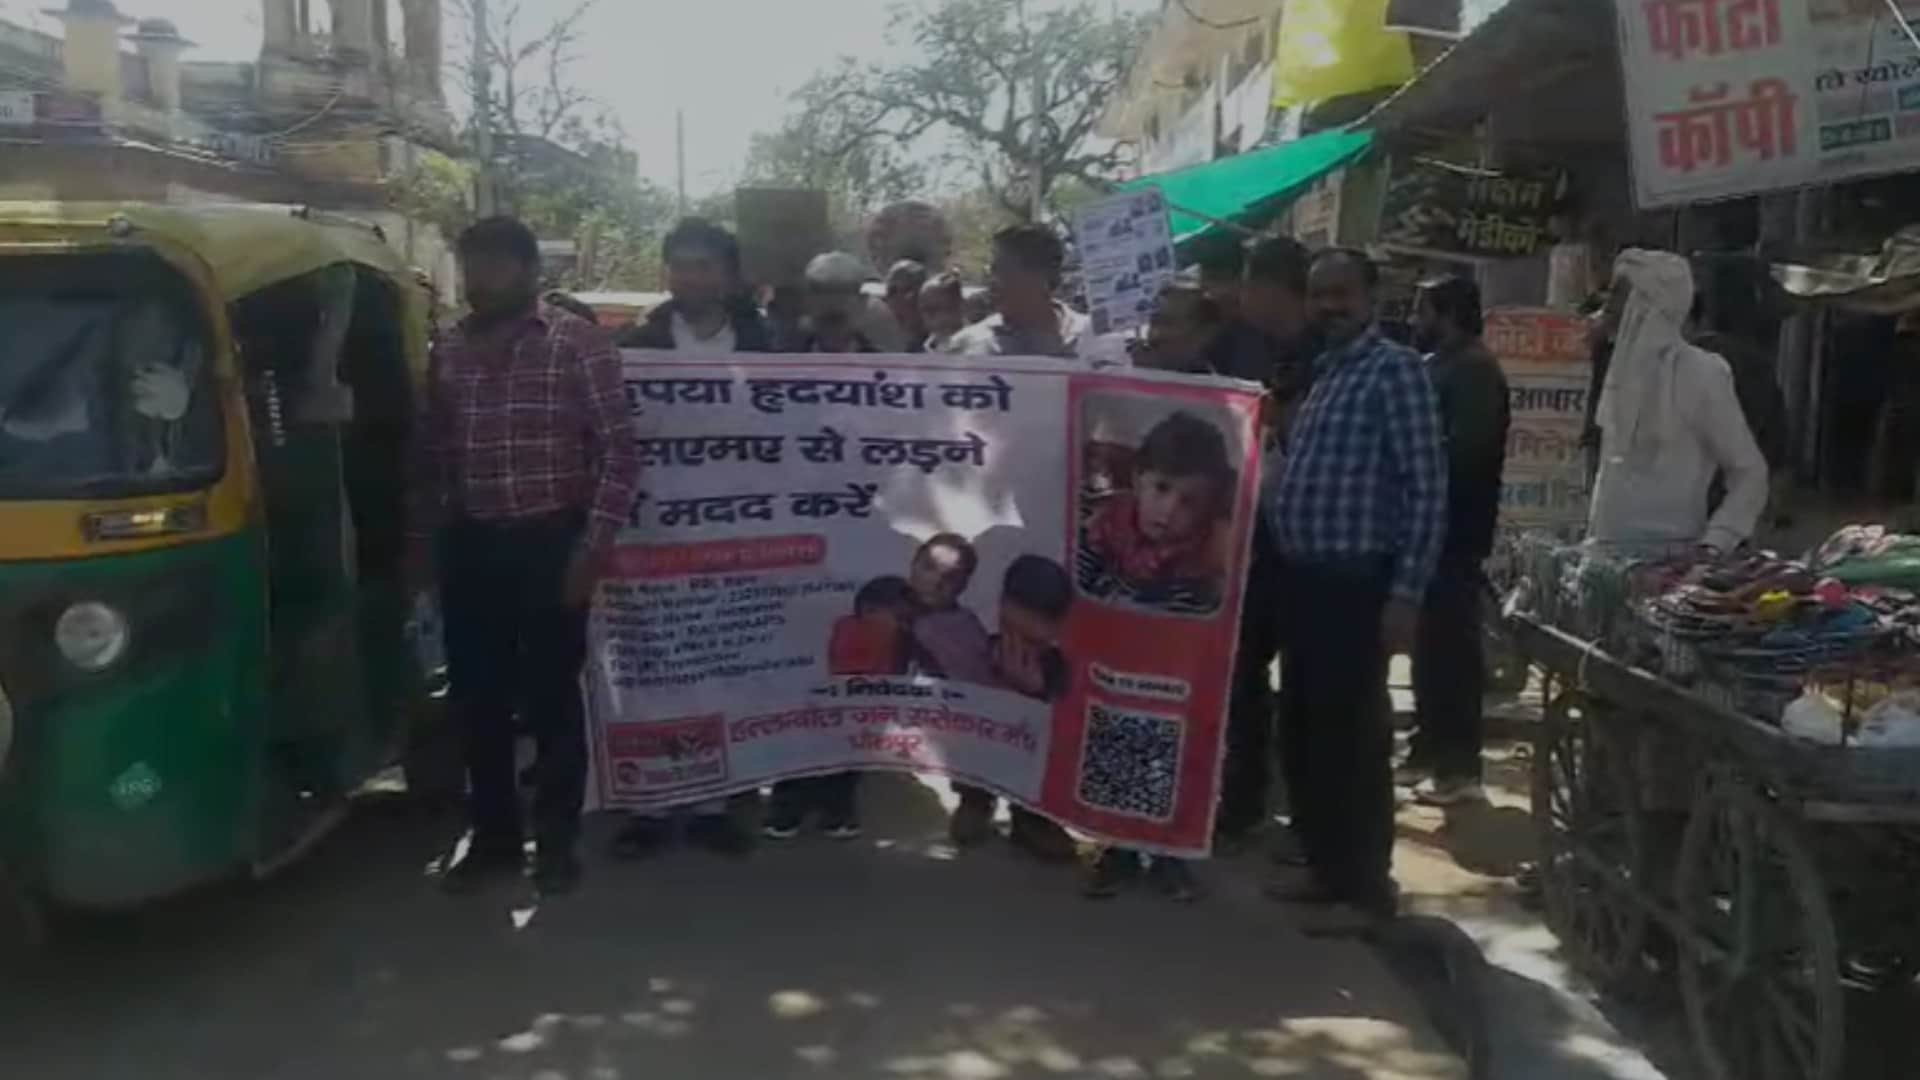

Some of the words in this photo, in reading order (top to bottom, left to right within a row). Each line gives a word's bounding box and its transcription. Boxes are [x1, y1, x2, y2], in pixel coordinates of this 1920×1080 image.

[1654, 77, 1798, 172] कॉपी
[746, 371, 927, 413] हृदयांश
[939, 375, 1014, 411] को
[797, 426, 846, 463] से
[859, 431, 987, 475] लड़ने
[656, 494, 777, 526] मदद
[788, 483, 879, 517] करें
